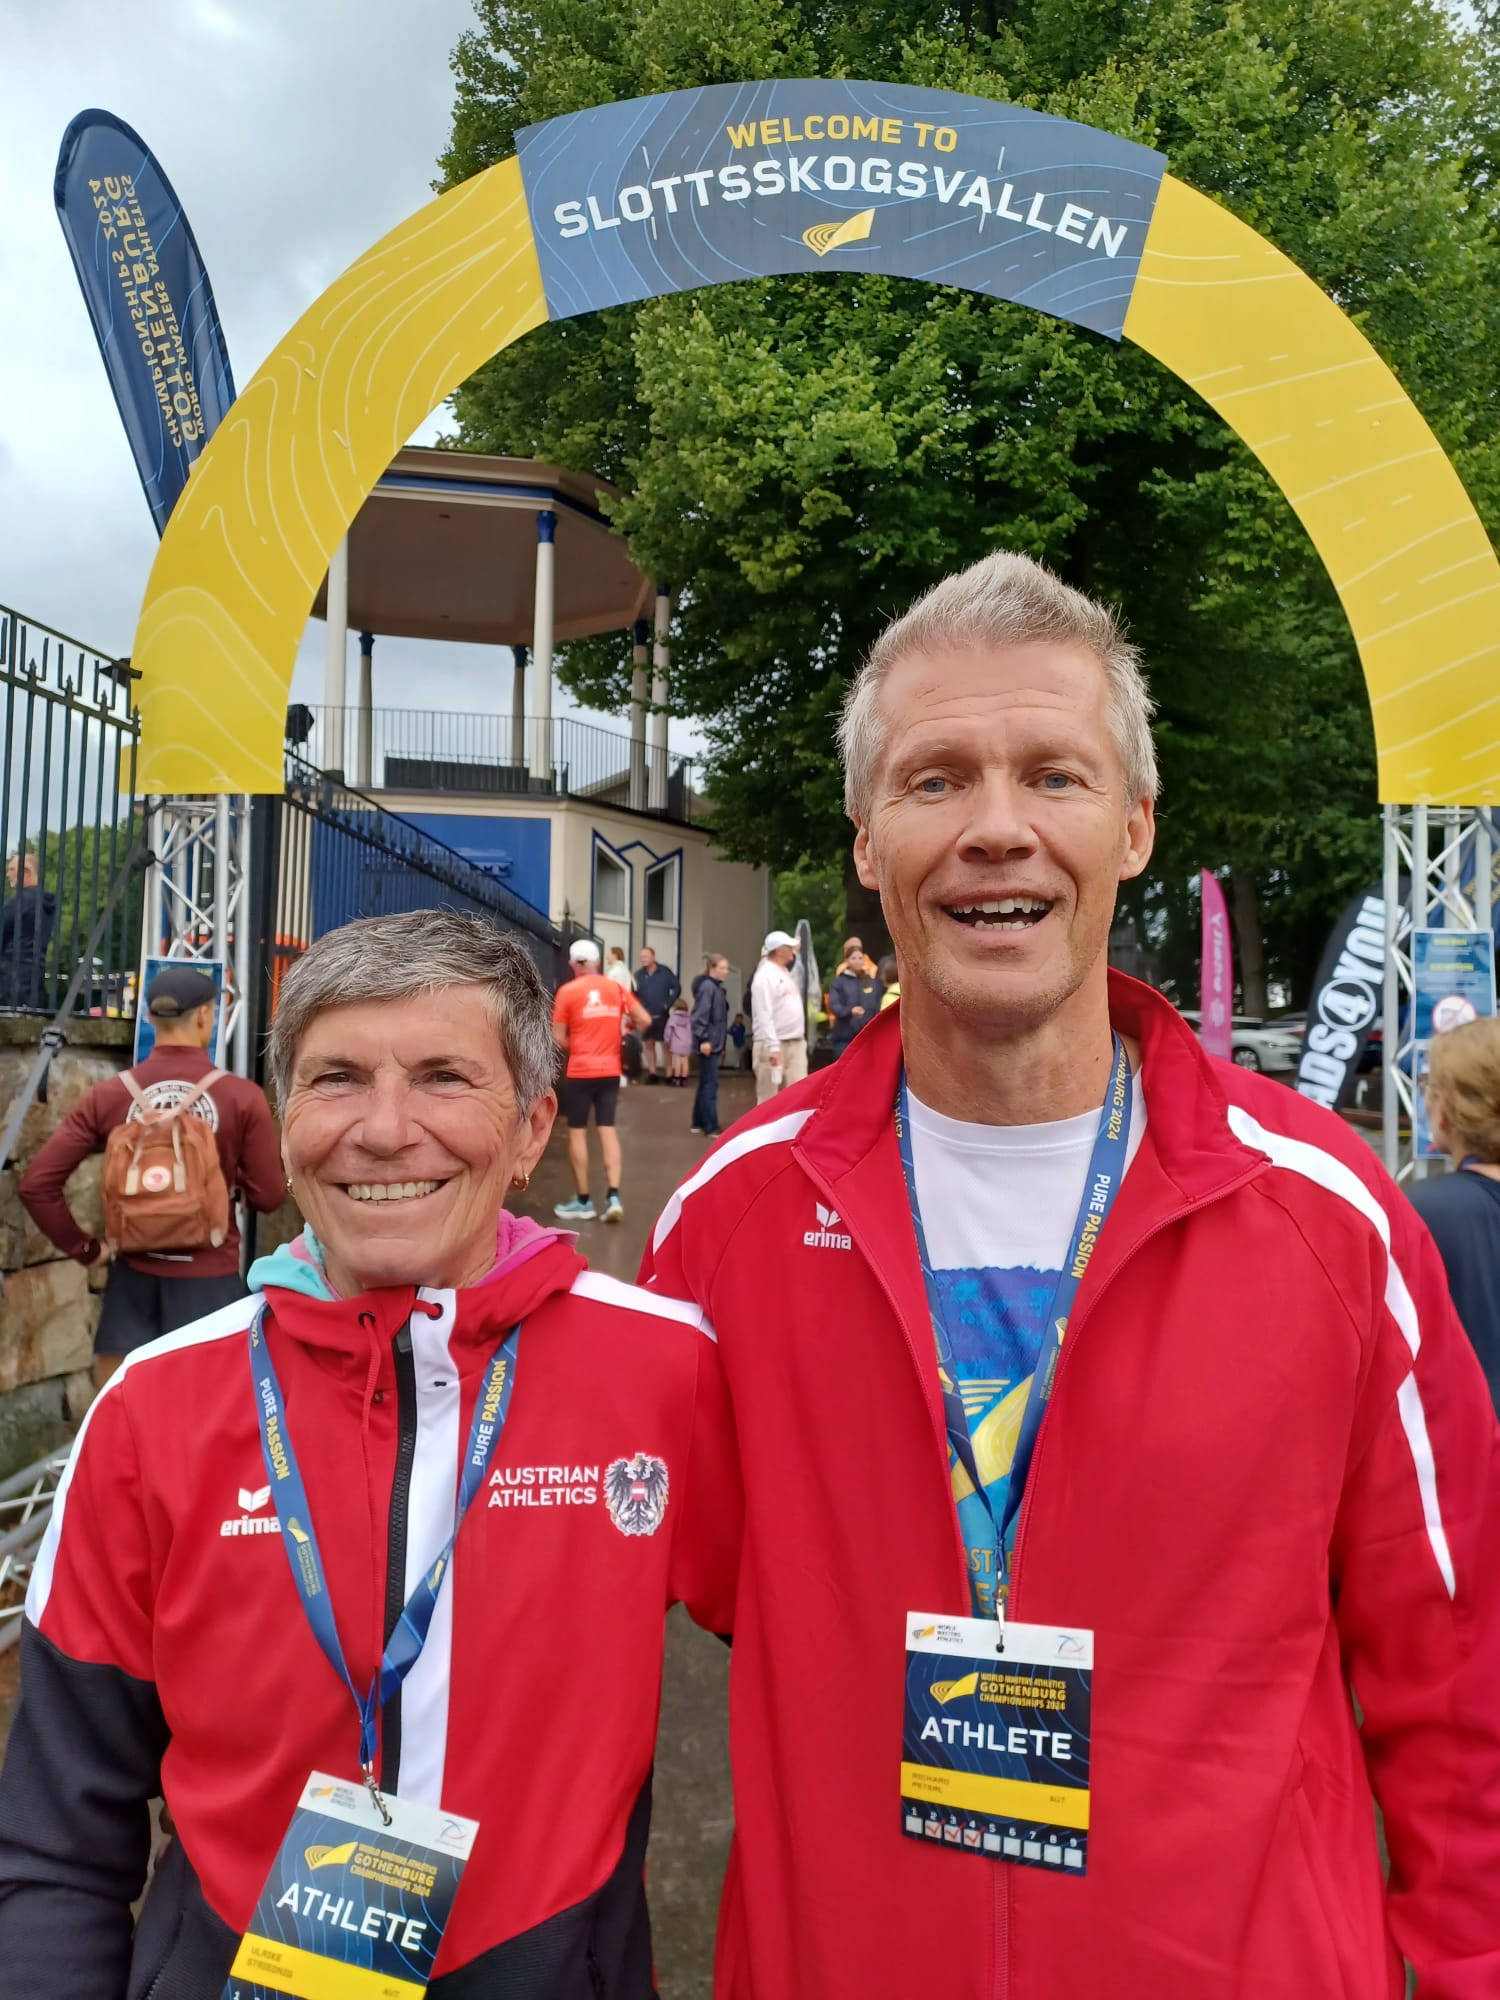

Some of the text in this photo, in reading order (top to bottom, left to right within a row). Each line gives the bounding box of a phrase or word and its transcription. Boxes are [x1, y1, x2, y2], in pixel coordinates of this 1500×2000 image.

[726, 114, 958, 153] WELCOME TO
[553, 155, 1129, 259] SLOTTSSKOGSVALLEN
[1106, 1107, 1123, 1140] 2024
[803, 1226, 852, 1251] erima
[1071, 1173, 1111, 1279] PURE PASSION
[260, 1377, 290, 1481] PURE PASSION
[472, 1360, 507, 1466] PURE PASSION
[489, 1466, 599, 1487] AUSTRIAN
[488, 1487, 597, 1508] ATHLETICS
[220, 1515, 282, 1536] erima
[980, 1681, 1066, 1701] GOTHENBURG
[920, 1716, 1073, 1761] ATHLETE
[930, 1811, 938, 1821] 2
[950, 1815, 957, 1825] 3
[969, 1819, 976, 1829] 4
[989, 1823, 996, 1833] 5
[1009, 1827, 1016, 1837] 6
[1029, 1830, 1037, 1840] 7
[1050, 1834, 1057, 1844] 8
[1069, 1838, 1077, 1848] 9
[354, 1853, 435, 1887] GOTHENBURG
[276, 1882, 427, 1952] ATHLETE
